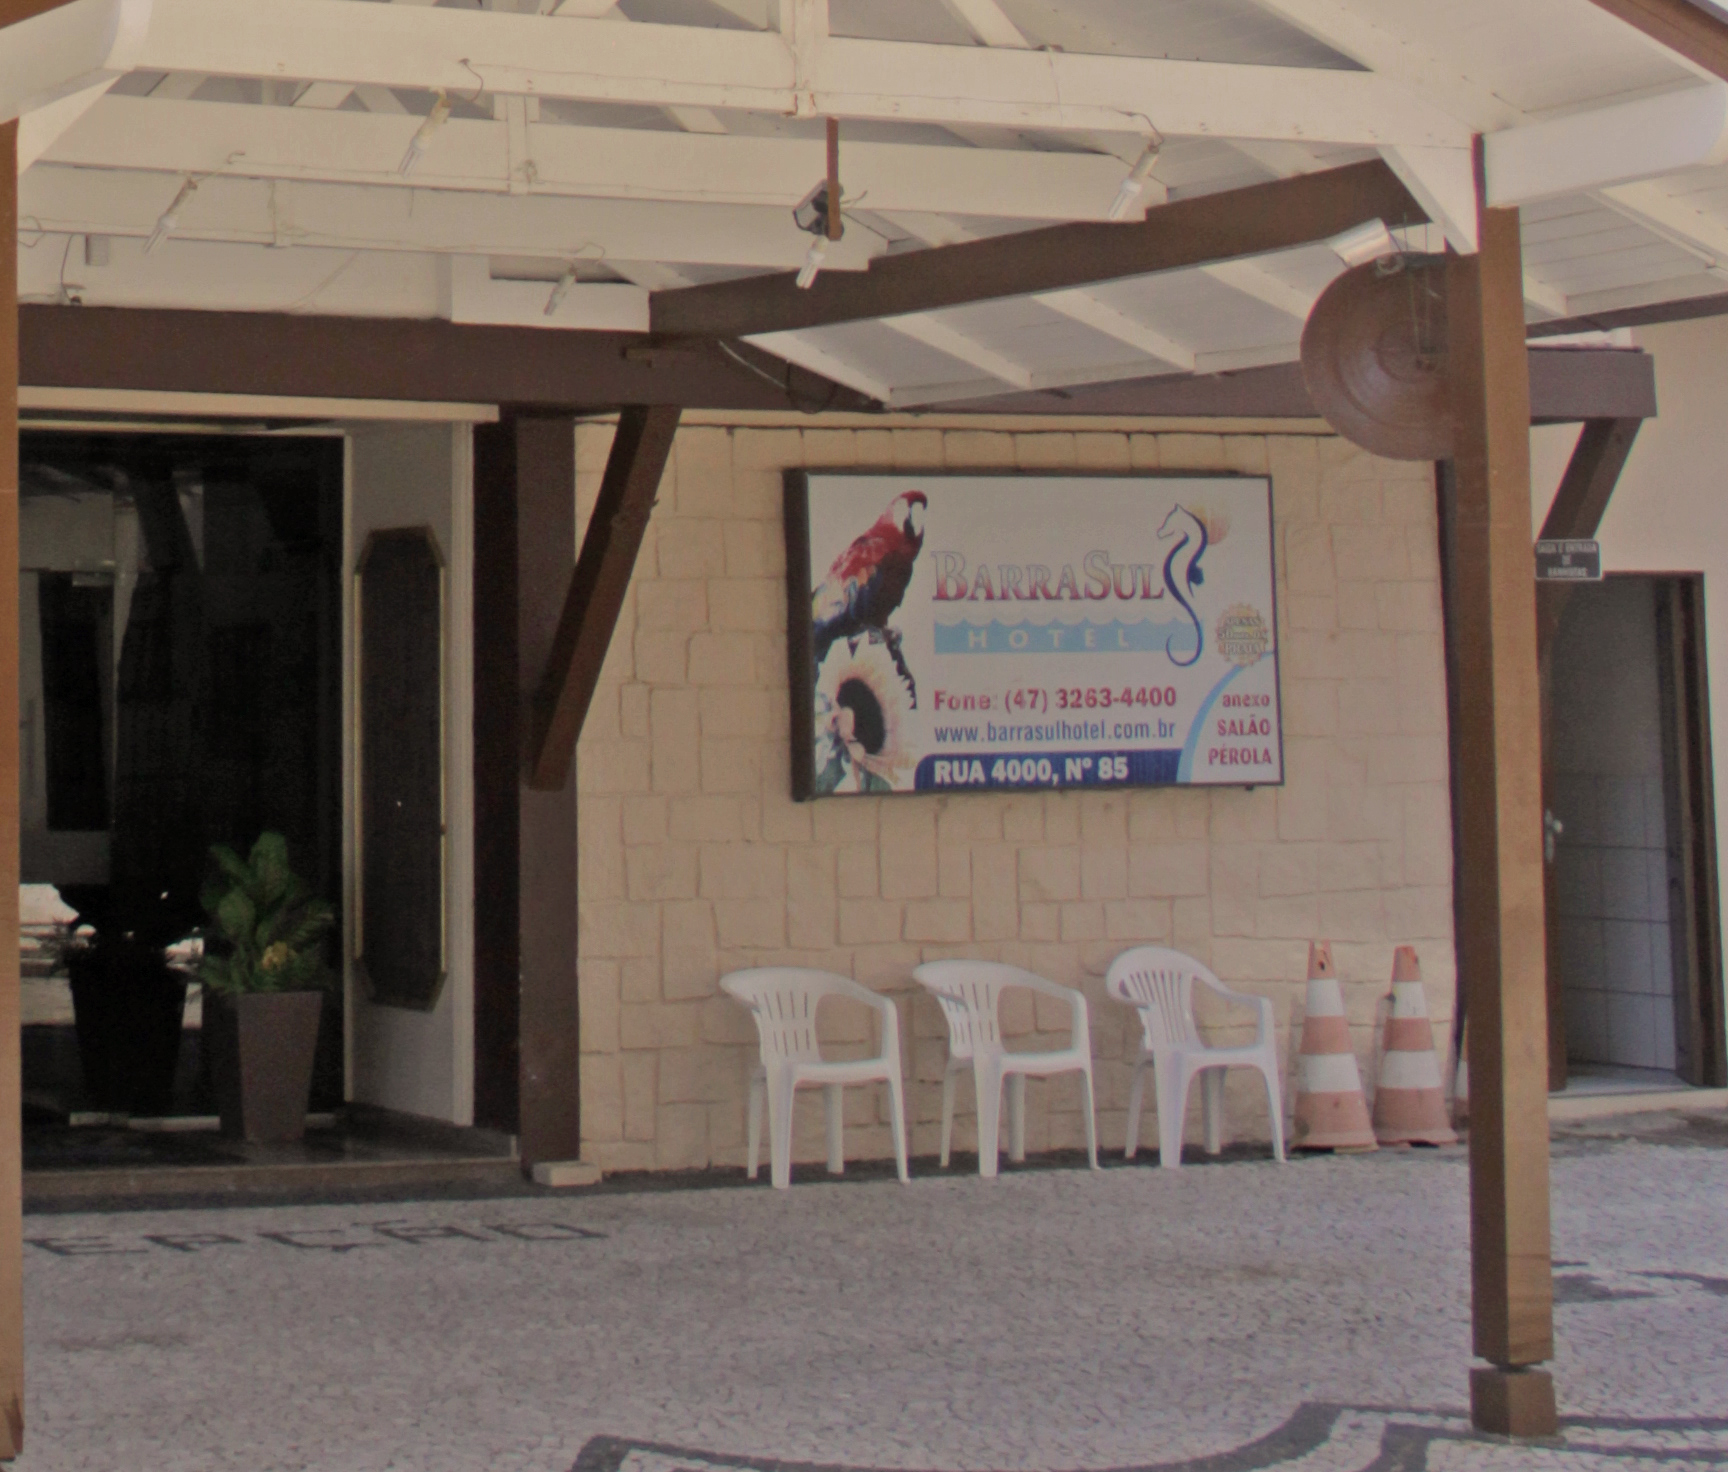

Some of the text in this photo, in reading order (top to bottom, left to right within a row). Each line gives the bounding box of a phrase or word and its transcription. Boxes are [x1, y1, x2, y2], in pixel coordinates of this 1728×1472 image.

[968, 628, 1130, 649] HOTEL
[933, 686, 1177, 714] Fone: (47) 3263-4400
[1222, 693, 1270, 708] anexo
[934, 718, 1177, 743] www.barrasulhotel.com.br
[1217, 713, 1271, 736] SALÃO
[1208, 743, 1272, 765] PÉROLA
[934, 759, 986, 784] RUA
[991, 757, 1059, 787] 4000,
[1098, 756, 1128, 780] 85
